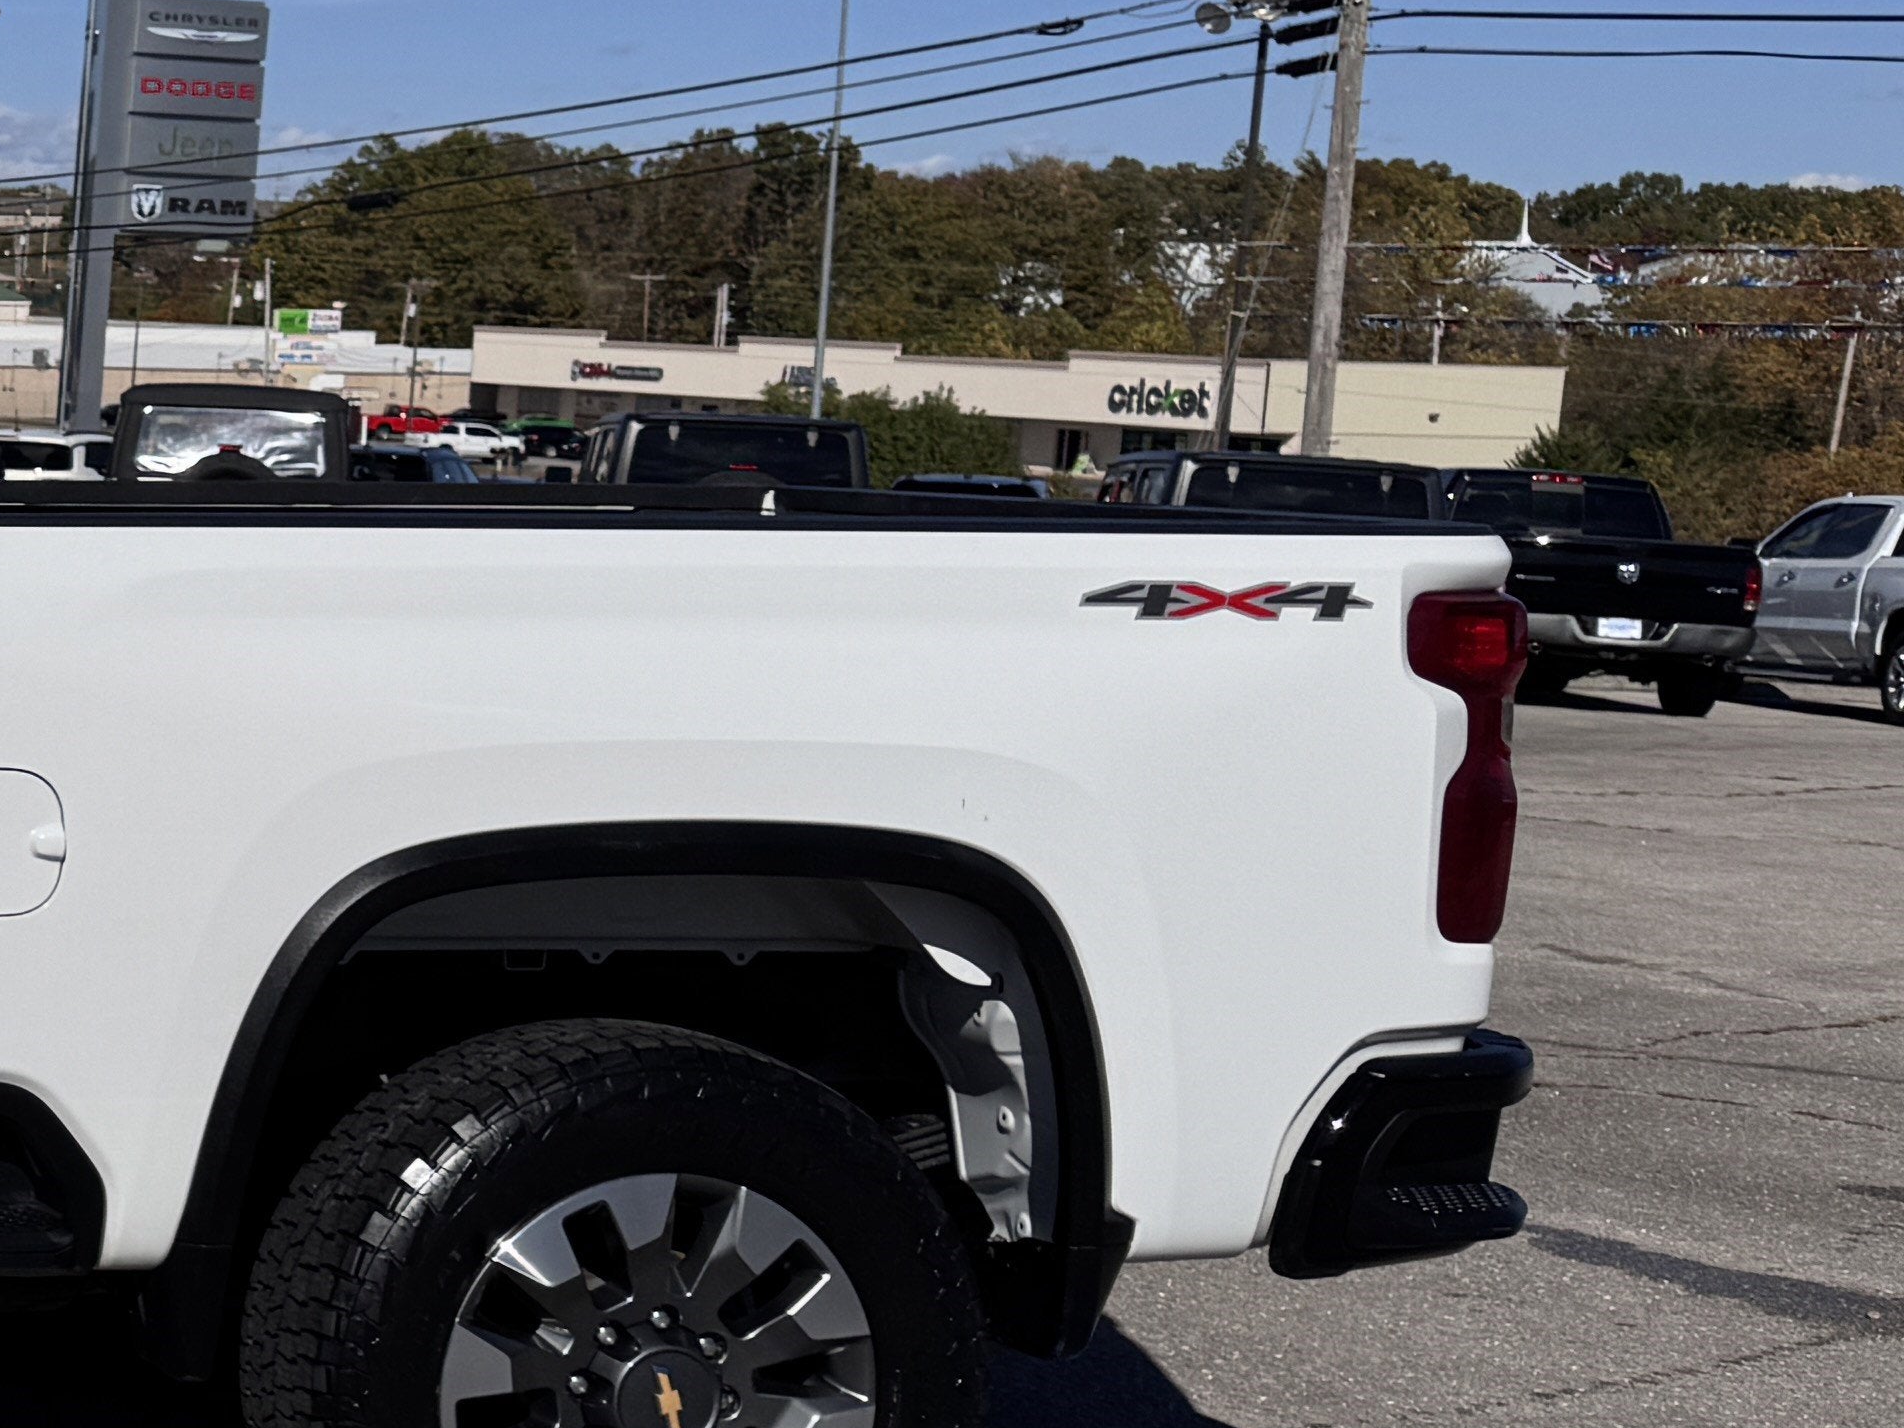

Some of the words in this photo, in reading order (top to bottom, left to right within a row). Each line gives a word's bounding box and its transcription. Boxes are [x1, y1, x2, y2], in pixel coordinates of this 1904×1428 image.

[148, 10, 259, 28] CHRYSLER
[141, 76, 256, 102] DODGE
[157, 125, 235, 166] Jeep
[167, 196, 248, 217] RAM
[1107, 377, 1211, 419] cricket
